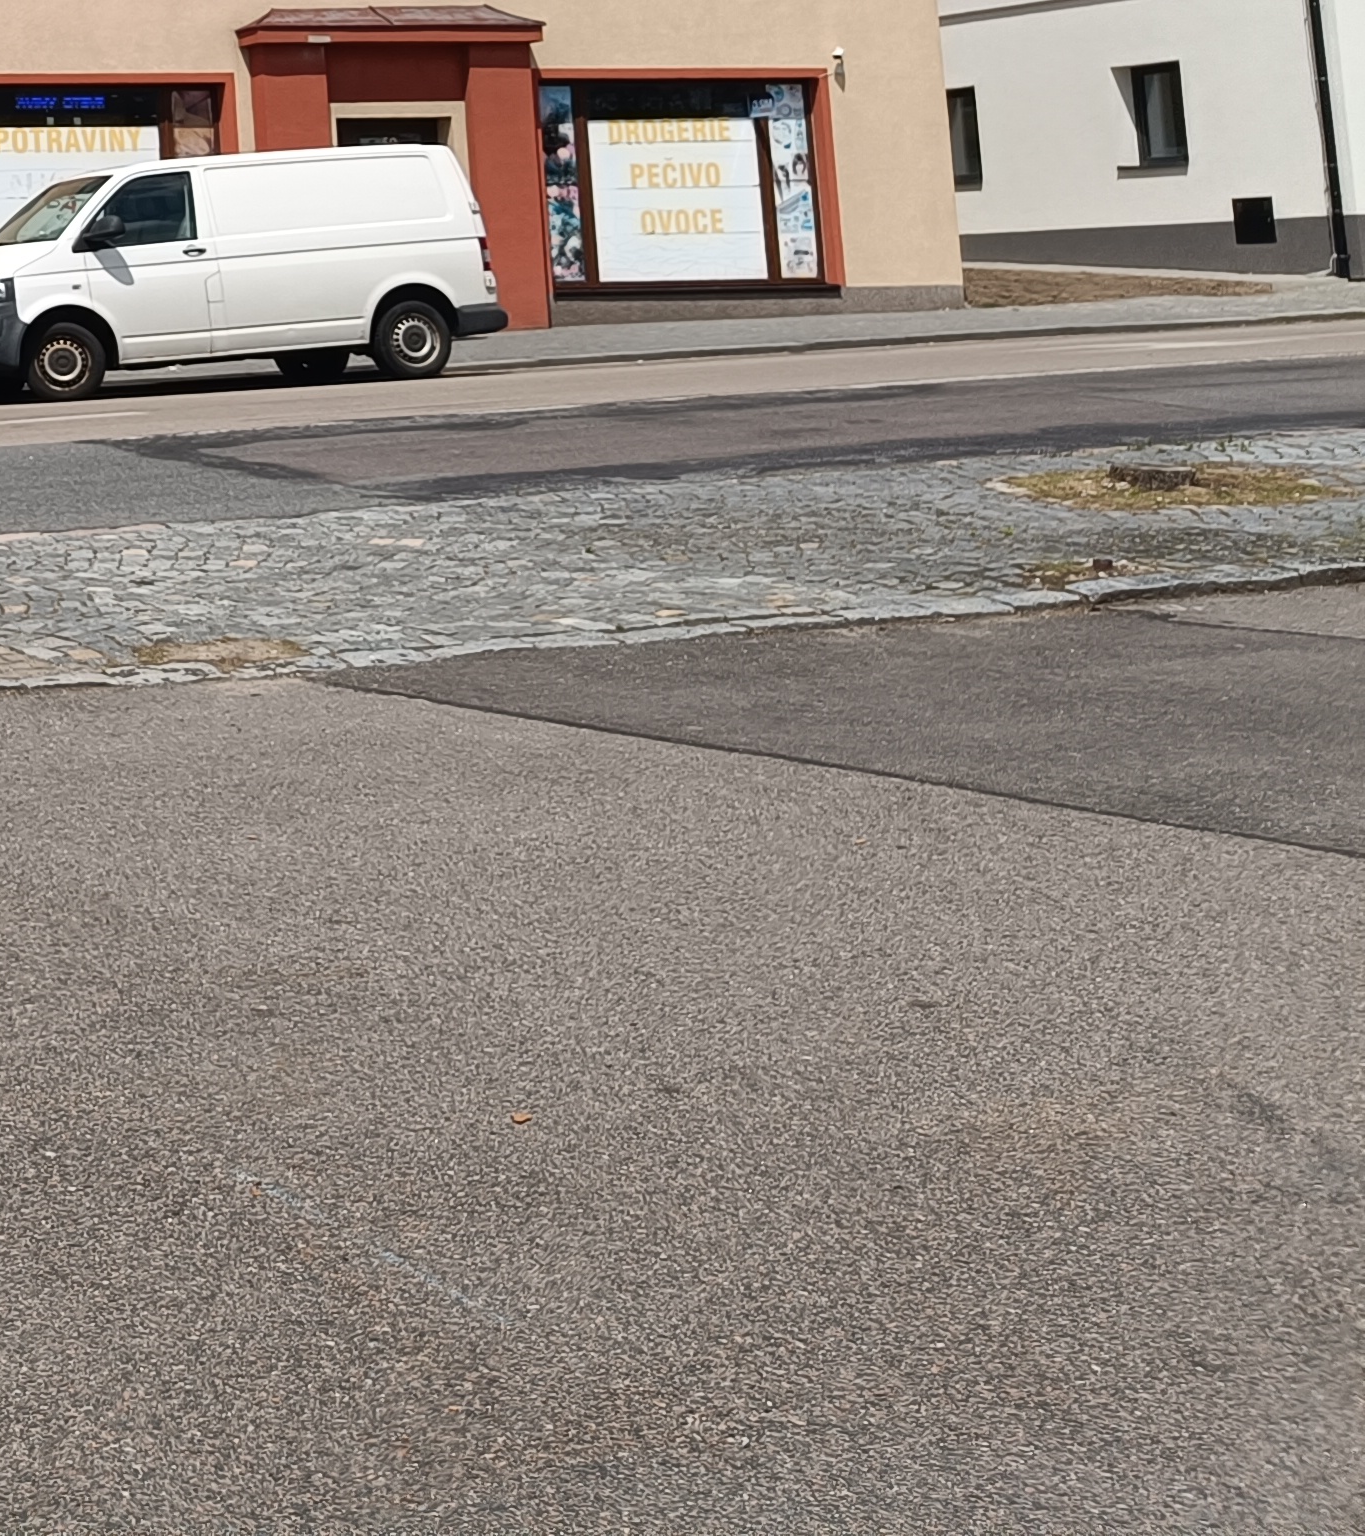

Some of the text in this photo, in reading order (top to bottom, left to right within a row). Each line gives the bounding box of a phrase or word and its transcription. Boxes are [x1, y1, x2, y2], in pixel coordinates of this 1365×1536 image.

[607, 118, 731, 145] DROGERIE
[629, 157, 722, 189] PEČIVO
[640, 209, 725, 235] OVOCE
